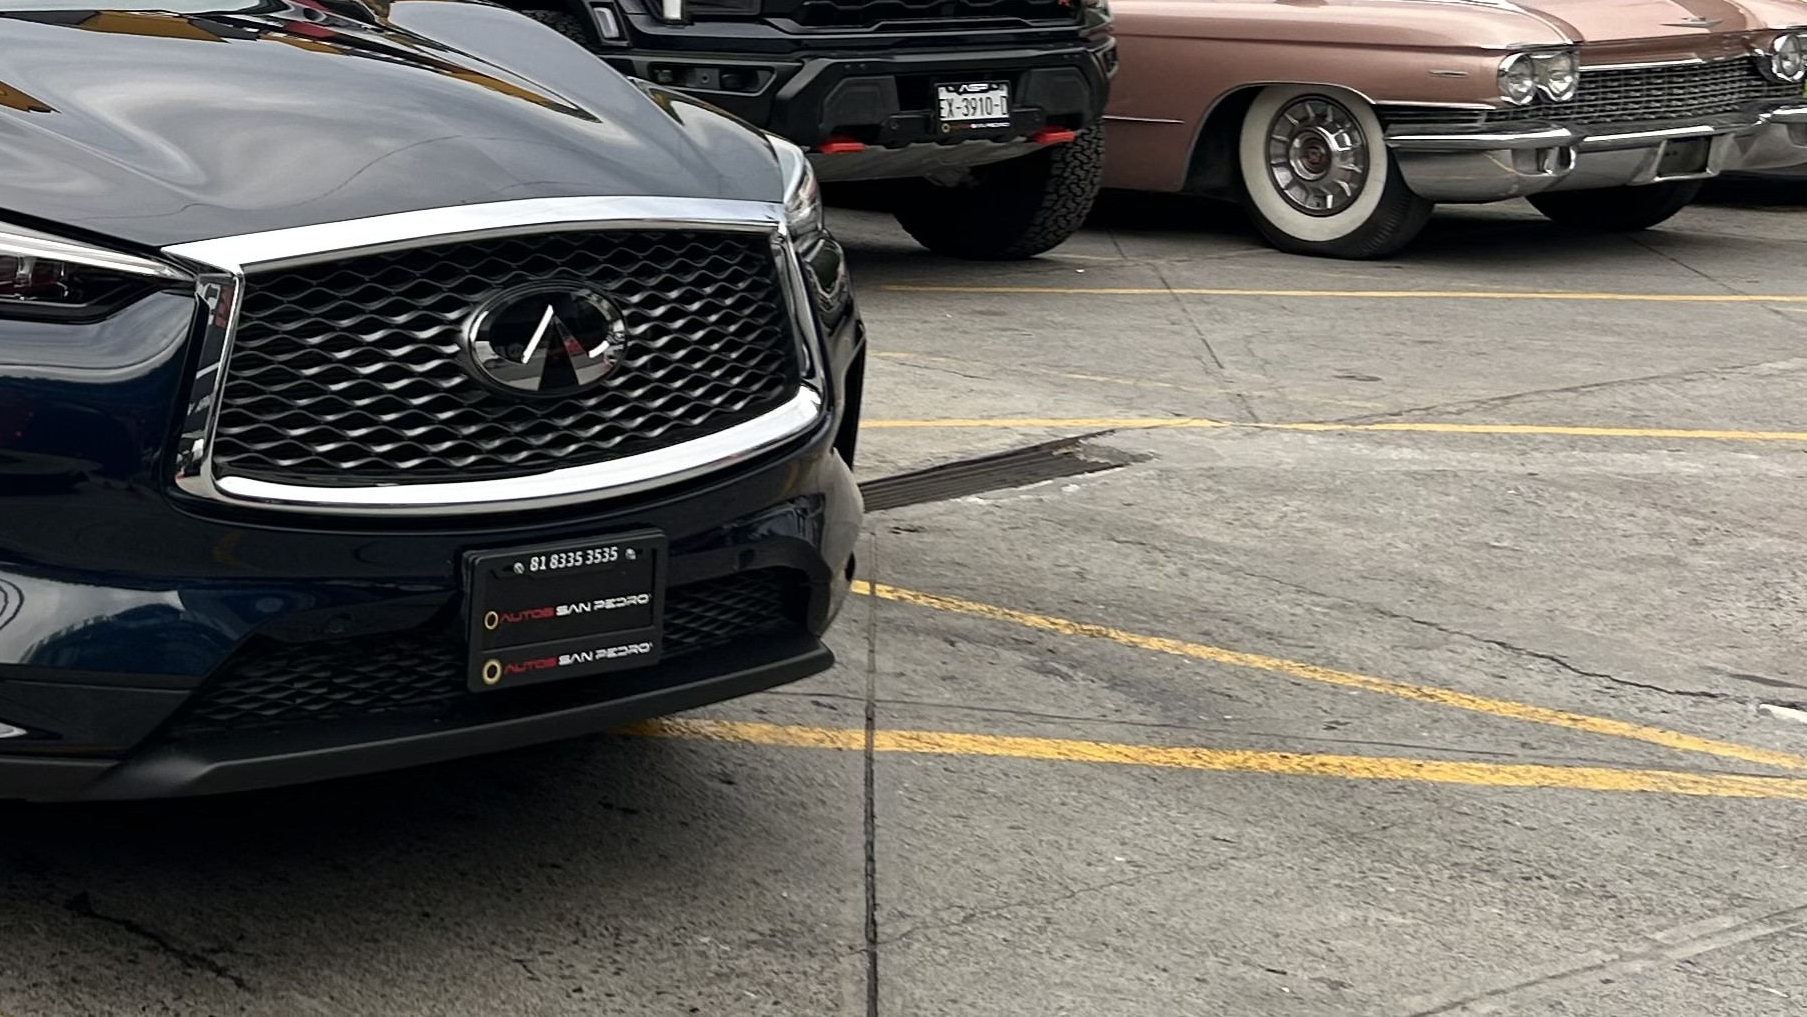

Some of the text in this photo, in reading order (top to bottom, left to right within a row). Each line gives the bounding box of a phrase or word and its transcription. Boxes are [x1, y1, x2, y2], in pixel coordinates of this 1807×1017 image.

[529, 546, 619, 572] 81 8335 3535
[499, 593, 650, 624] AUTOS SAN PEDRO
[504, 642, 651, 674] AUTOS SAN PEDRO
